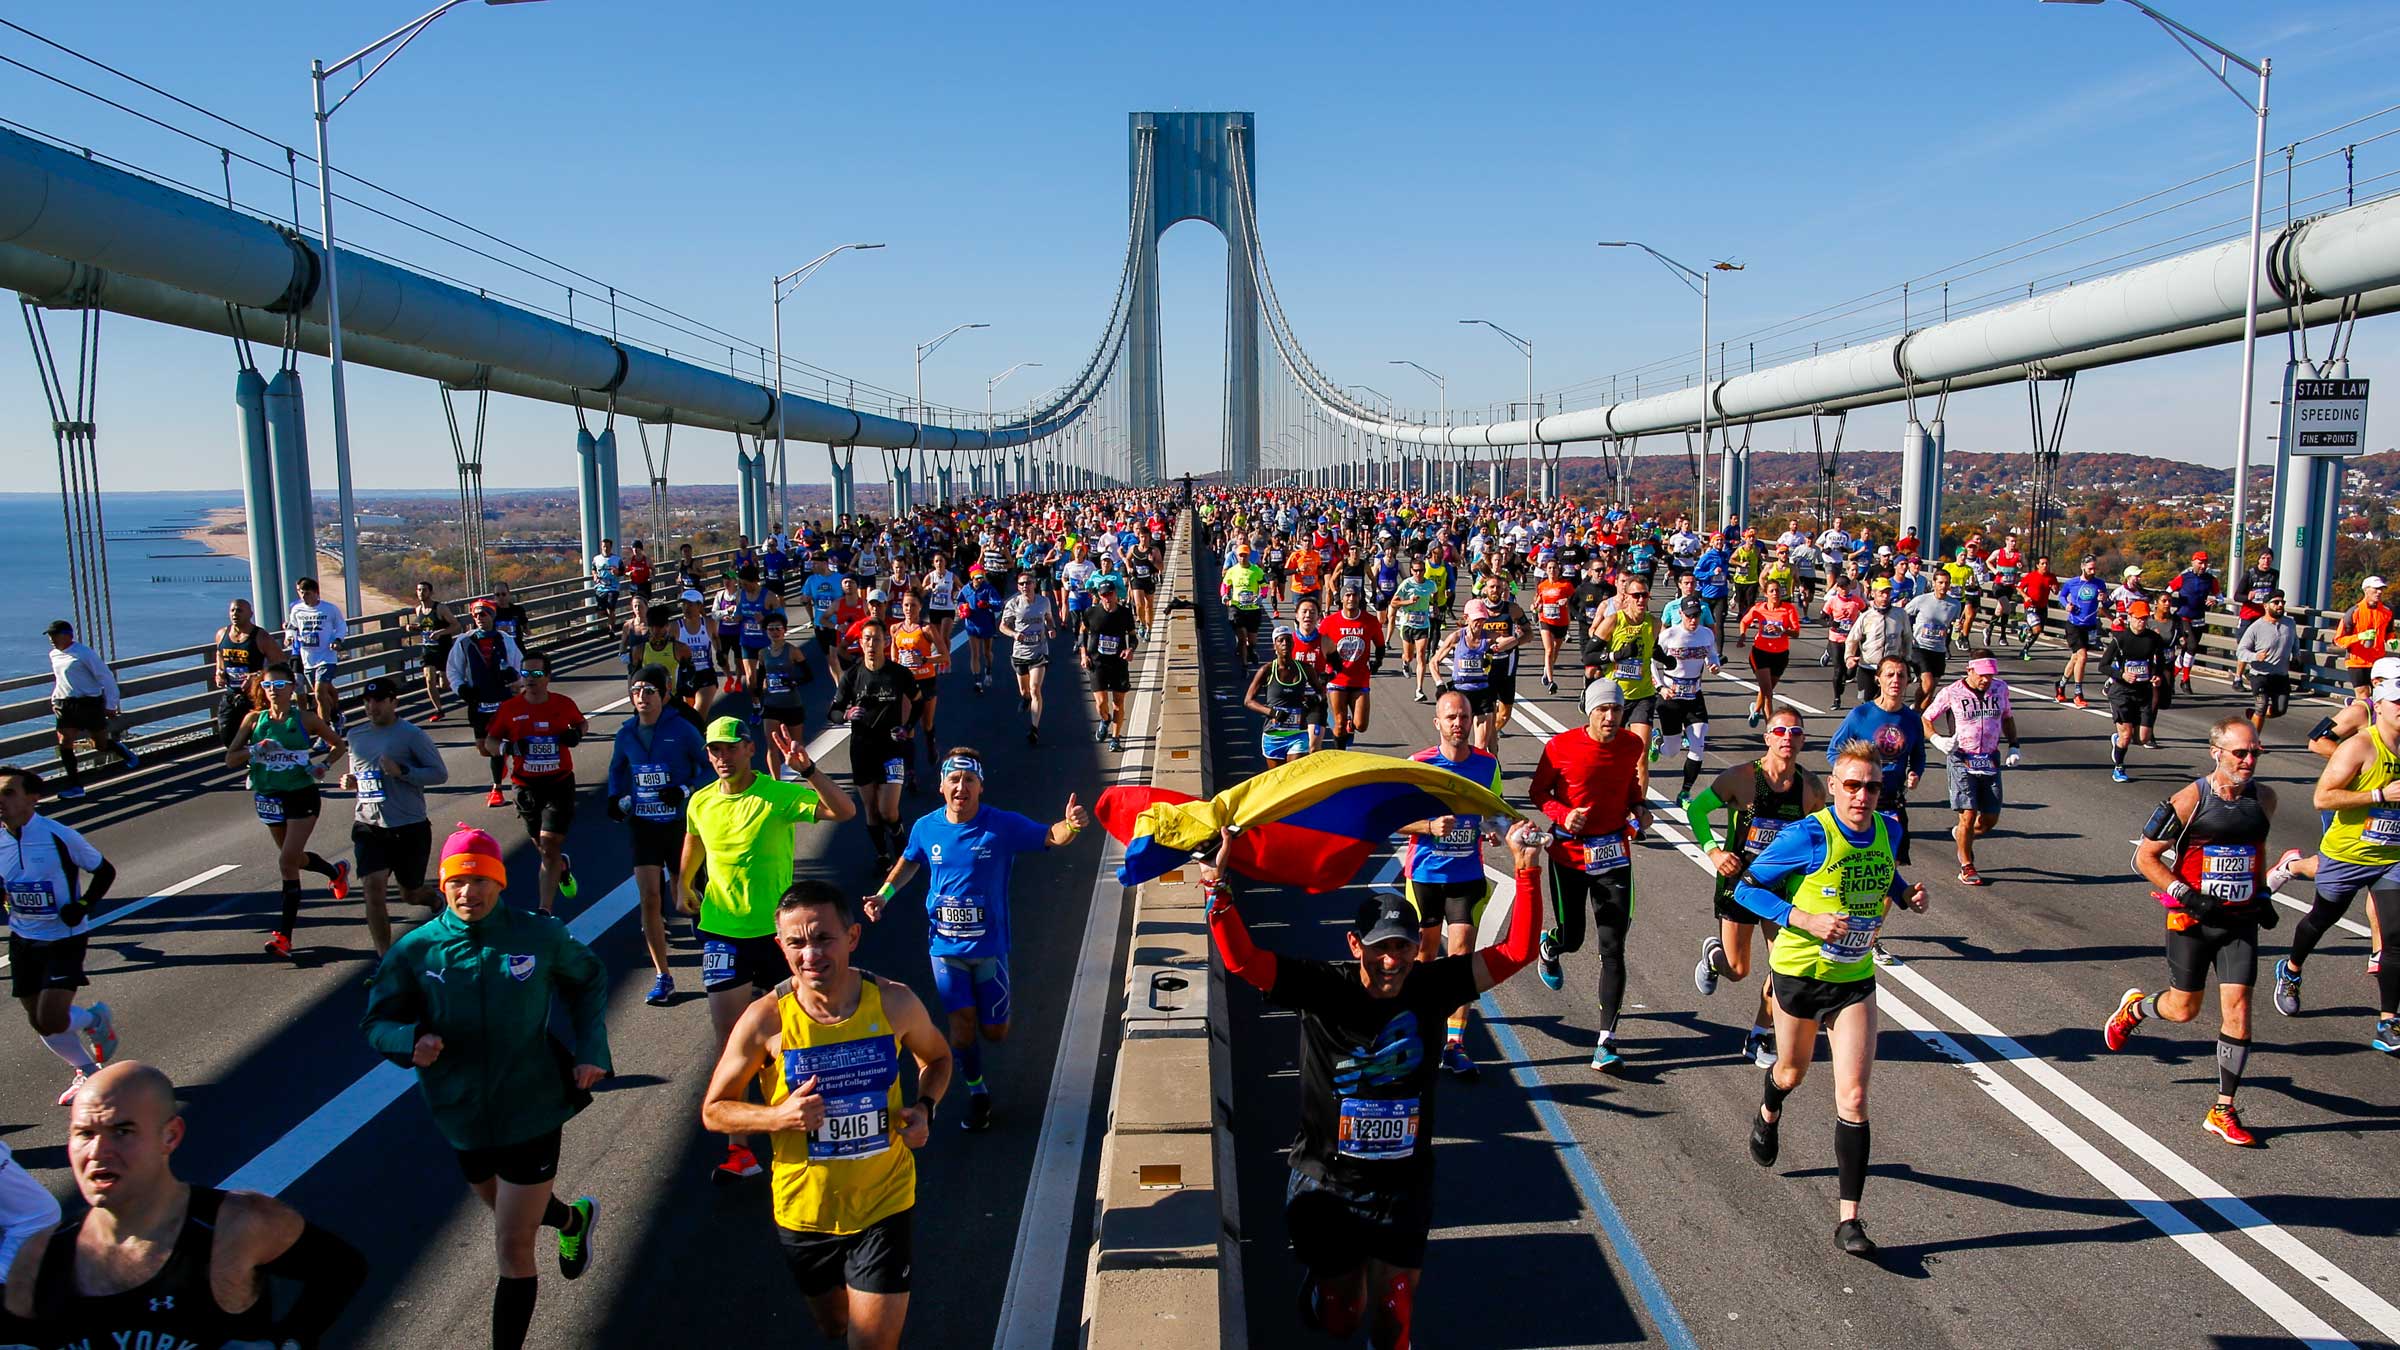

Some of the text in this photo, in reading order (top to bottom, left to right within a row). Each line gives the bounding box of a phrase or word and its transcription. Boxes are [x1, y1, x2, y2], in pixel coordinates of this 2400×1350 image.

[2298, 383, 2367, 396] STATE LAW
[2301, 408, 2359, 421] SPEEDING
[2302, 434, 2319, 444] FINE
[1340, 627, 1364, 635] TEAM
[222, 648, 249, 658] NYPD
[1961, 697, 2000, 711] PINK
[532, 744, 552, 754] 8568
[1758, 830, 1776, 843] 128
[1595, 844, 1617, 861] 12851
[1844, 864, 1885, 879] TEAM
[2216, 857, 2245, 872] 11223
[1851, 878, 1885, 893] KIDS
[2209, 882, 2249, 899] KENT
[16, 893, 42, 906] 4090
[946, 908, 973, 922] 9895
[817, 1073, 856, 1083] Economics
[857, 1067, 888, 1077] Institute
[816, 1078, 872, 1092] of Bard College
[829, 1115, 868, 1140] 9416
[1355, 1119, 1403, 1140] 12309
